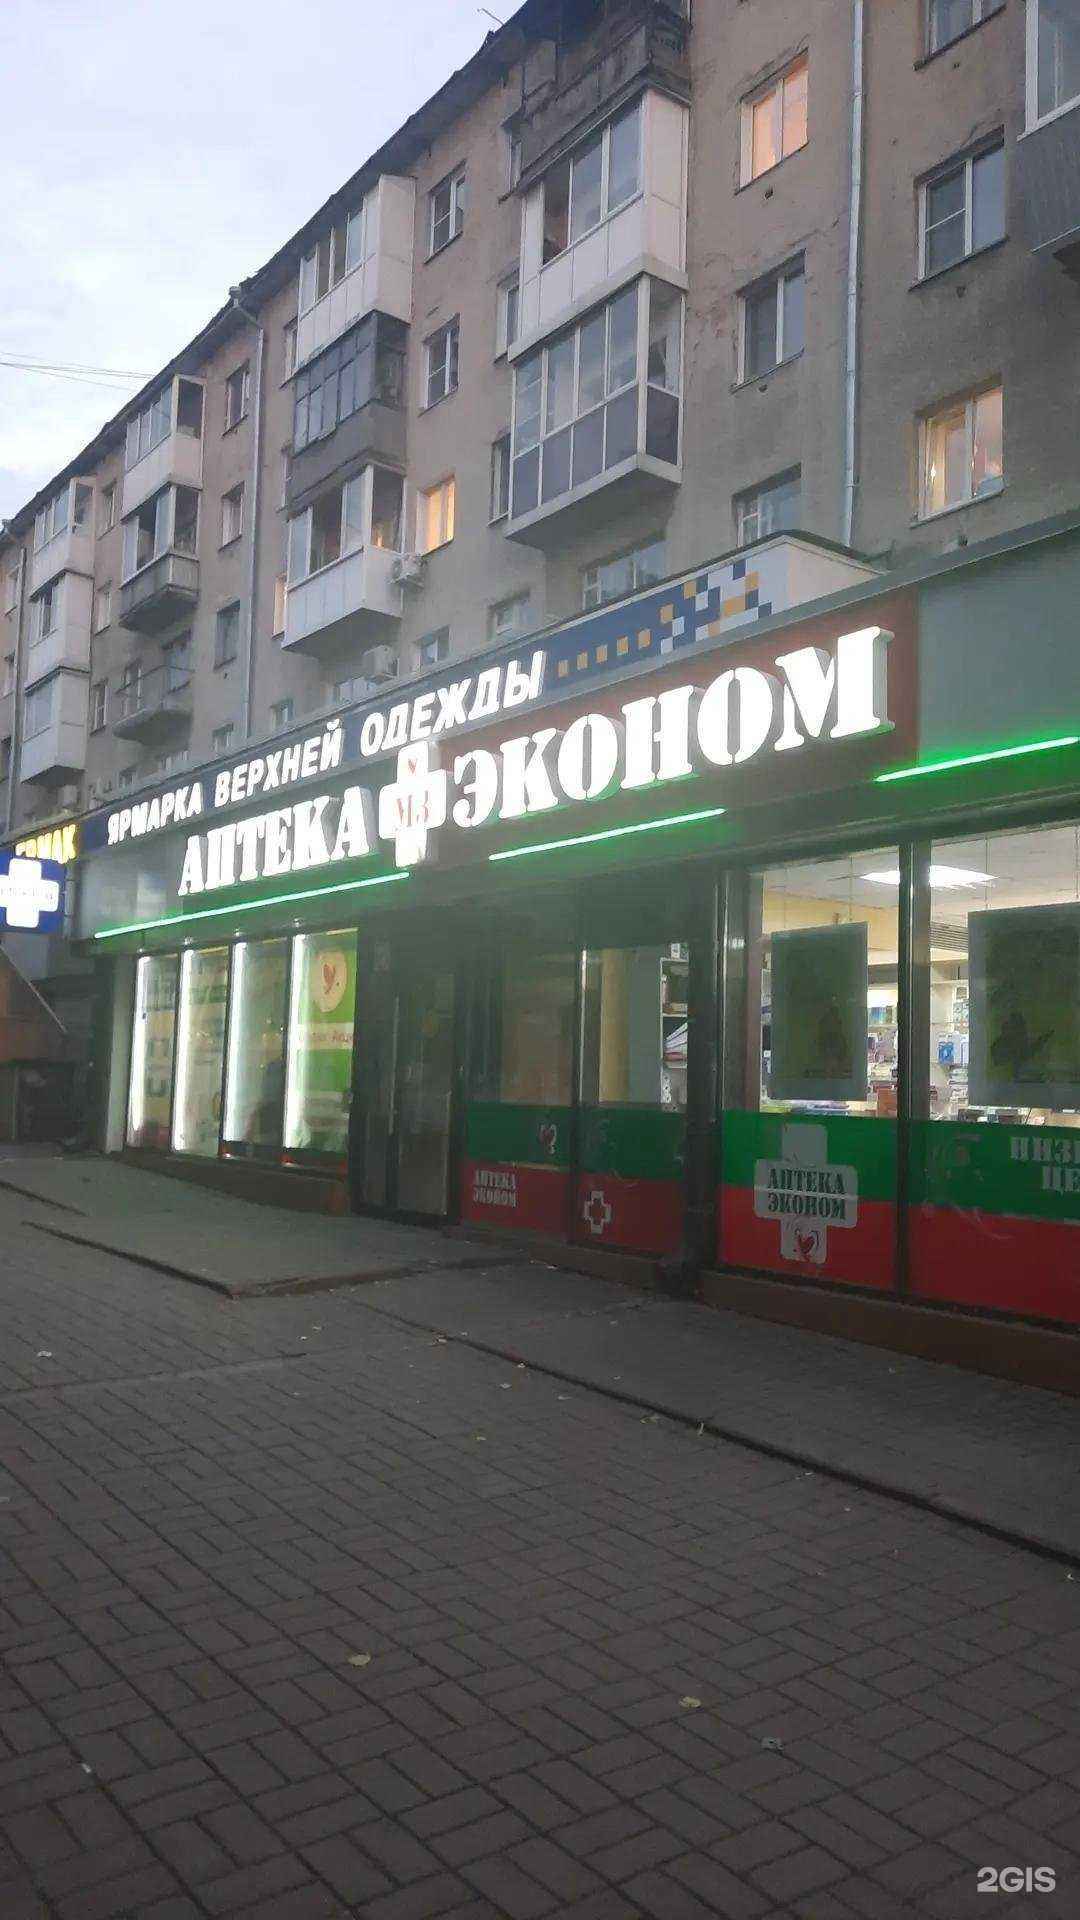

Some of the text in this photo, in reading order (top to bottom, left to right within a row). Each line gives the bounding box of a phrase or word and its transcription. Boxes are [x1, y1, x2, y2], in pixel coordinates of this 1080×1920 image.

[107, 650, 547, 846] ЯРМАРКА ВЕРХНЕЙ ОДЕЖДЫ
[178, 625, 889, 896] АПТЕКА ЭКОНОМ
[473, 1169, 518, 1189] АПТЕКА
[767, 1168, 846, 1195] АПТЕКА
[767, 1192, 847, 1220] ЭКОНОМ
